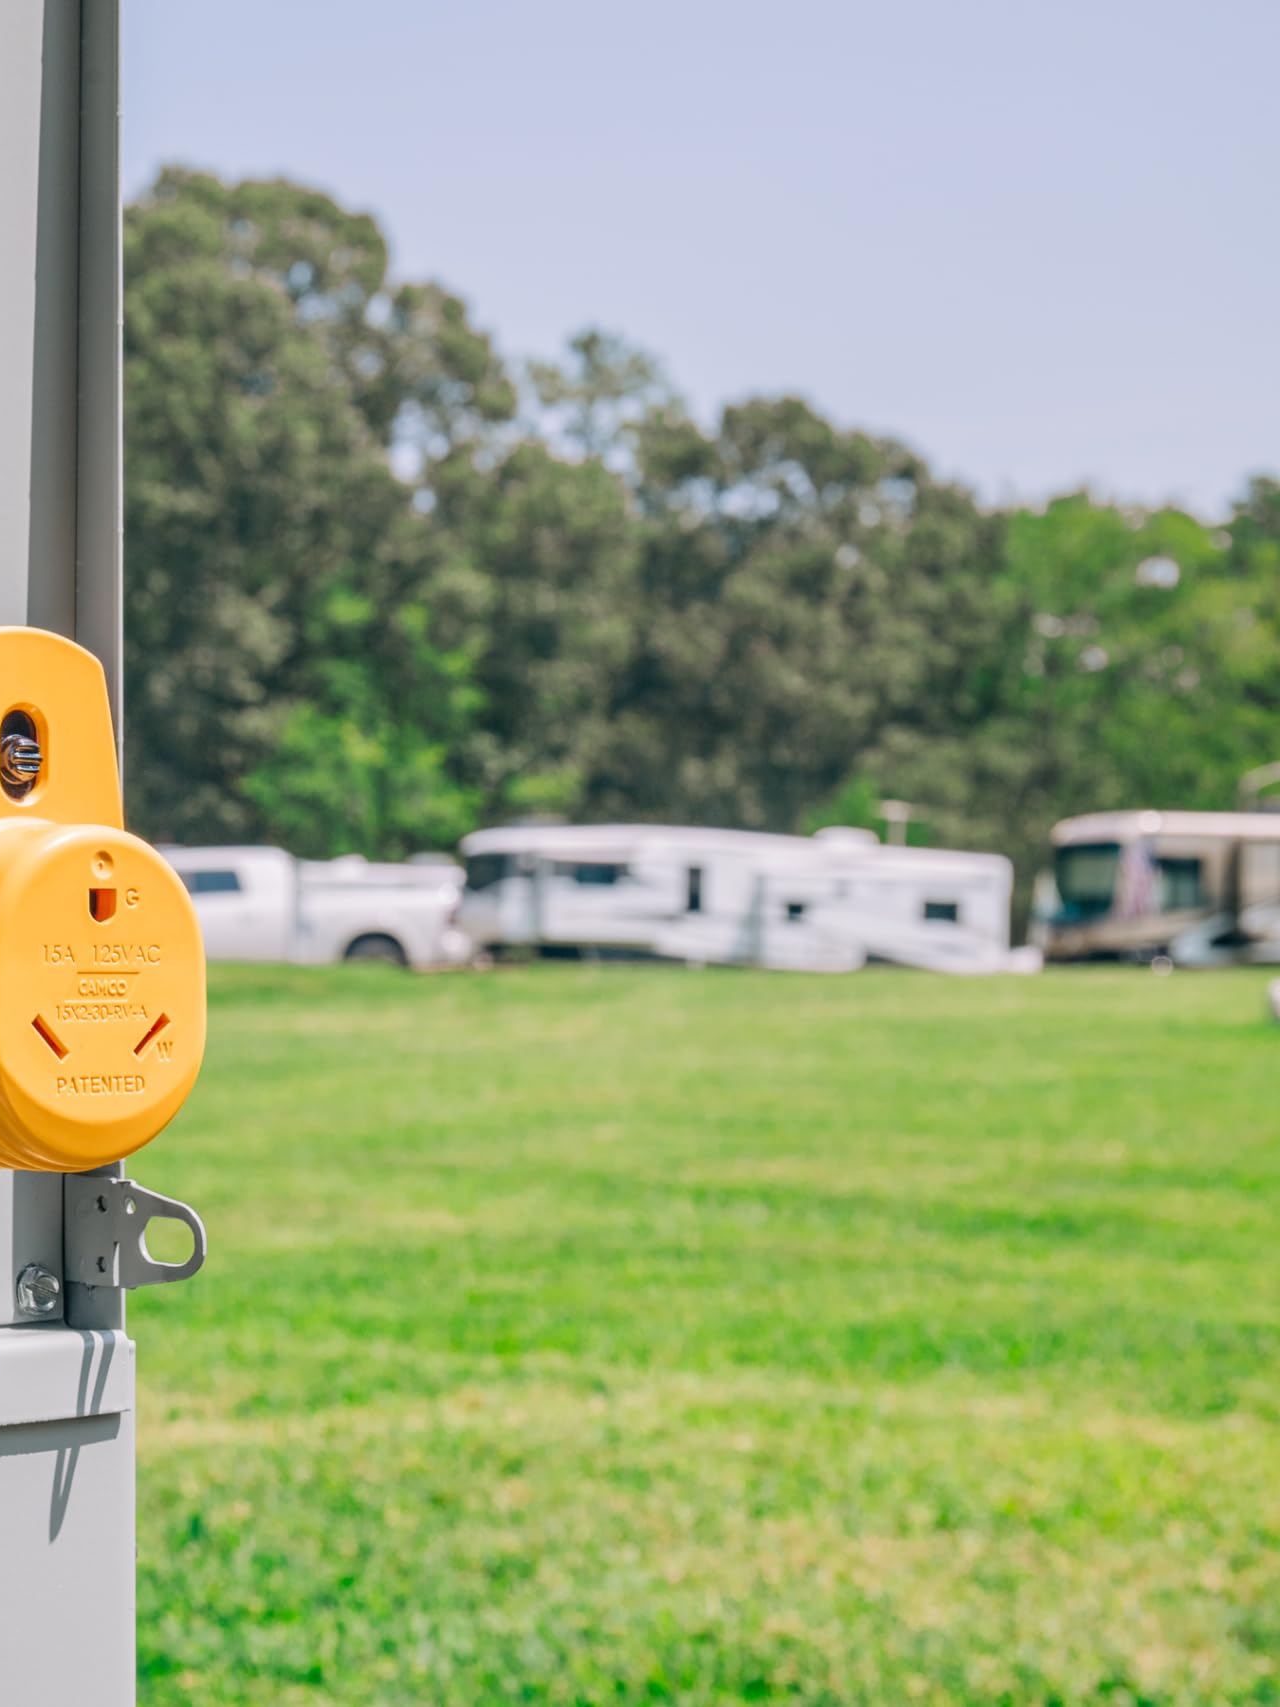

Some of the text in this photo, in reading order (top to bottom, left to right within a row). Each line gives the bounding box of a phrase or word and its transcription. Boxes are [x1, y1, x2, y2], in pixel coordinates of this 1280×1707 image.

[125, 888, 140, 909] G
[42, 944, 76, 966] 15A
[77, 978, 129, 997] CAMCO
[156, 1041, 174, 1063] W
[55, 1074, 146, 1097] PATENTED
